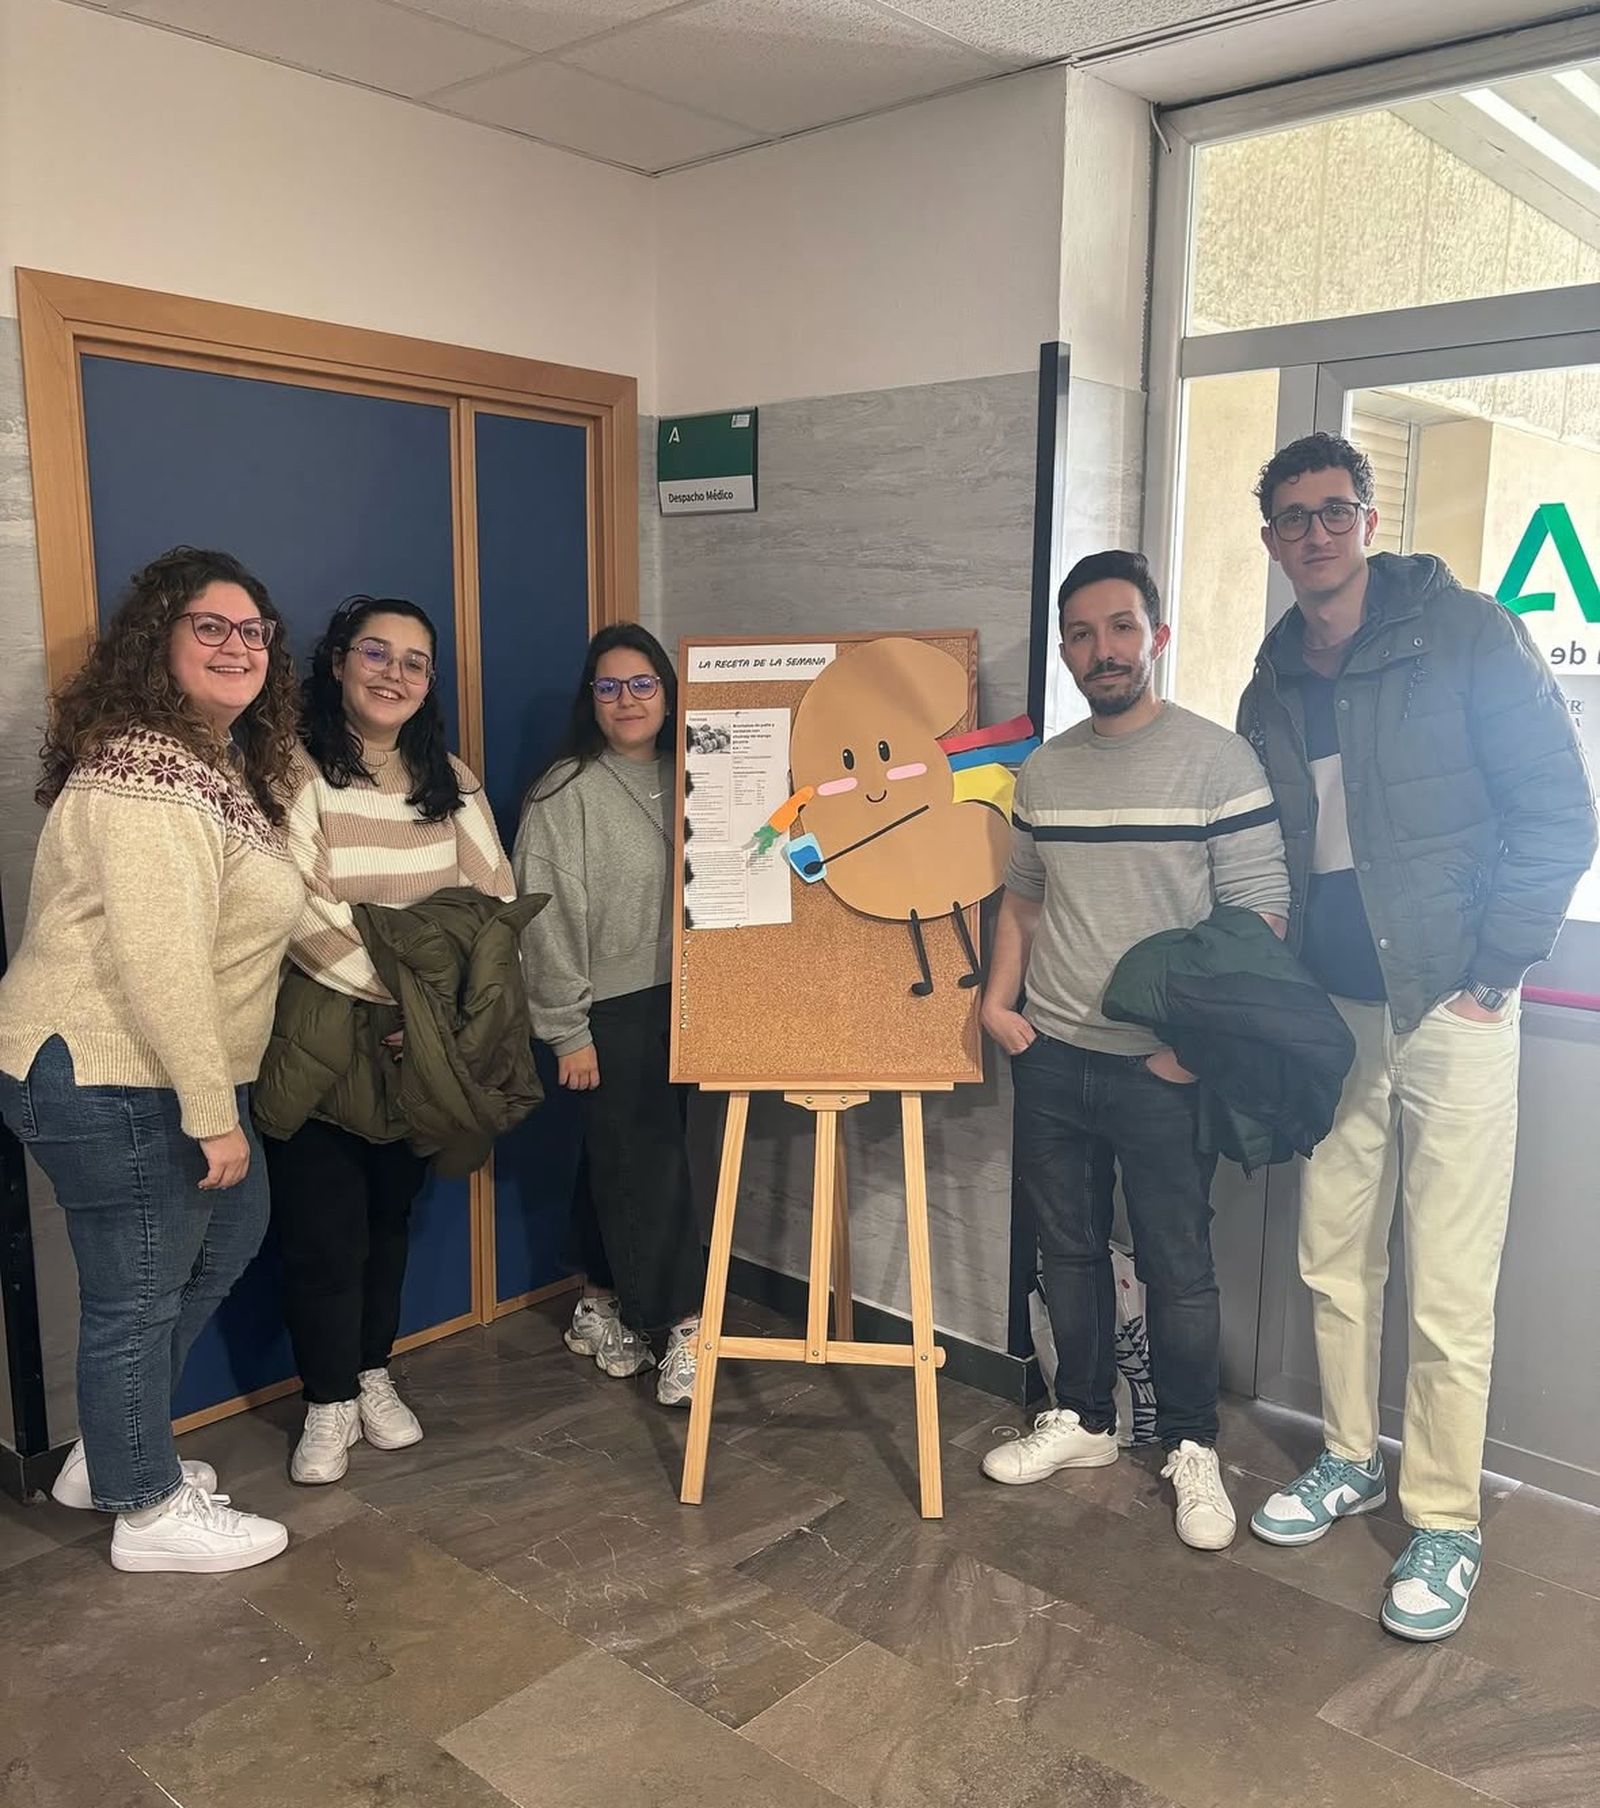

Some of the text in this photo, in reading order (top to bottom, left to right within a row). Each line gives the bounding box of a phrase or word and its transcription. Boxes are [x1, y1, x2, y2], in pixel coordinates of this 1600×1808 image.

[668, 489, 734, 504] Despacho Médico
[698, 656, 826, 668] LA RECETA DE LA SEMANA
